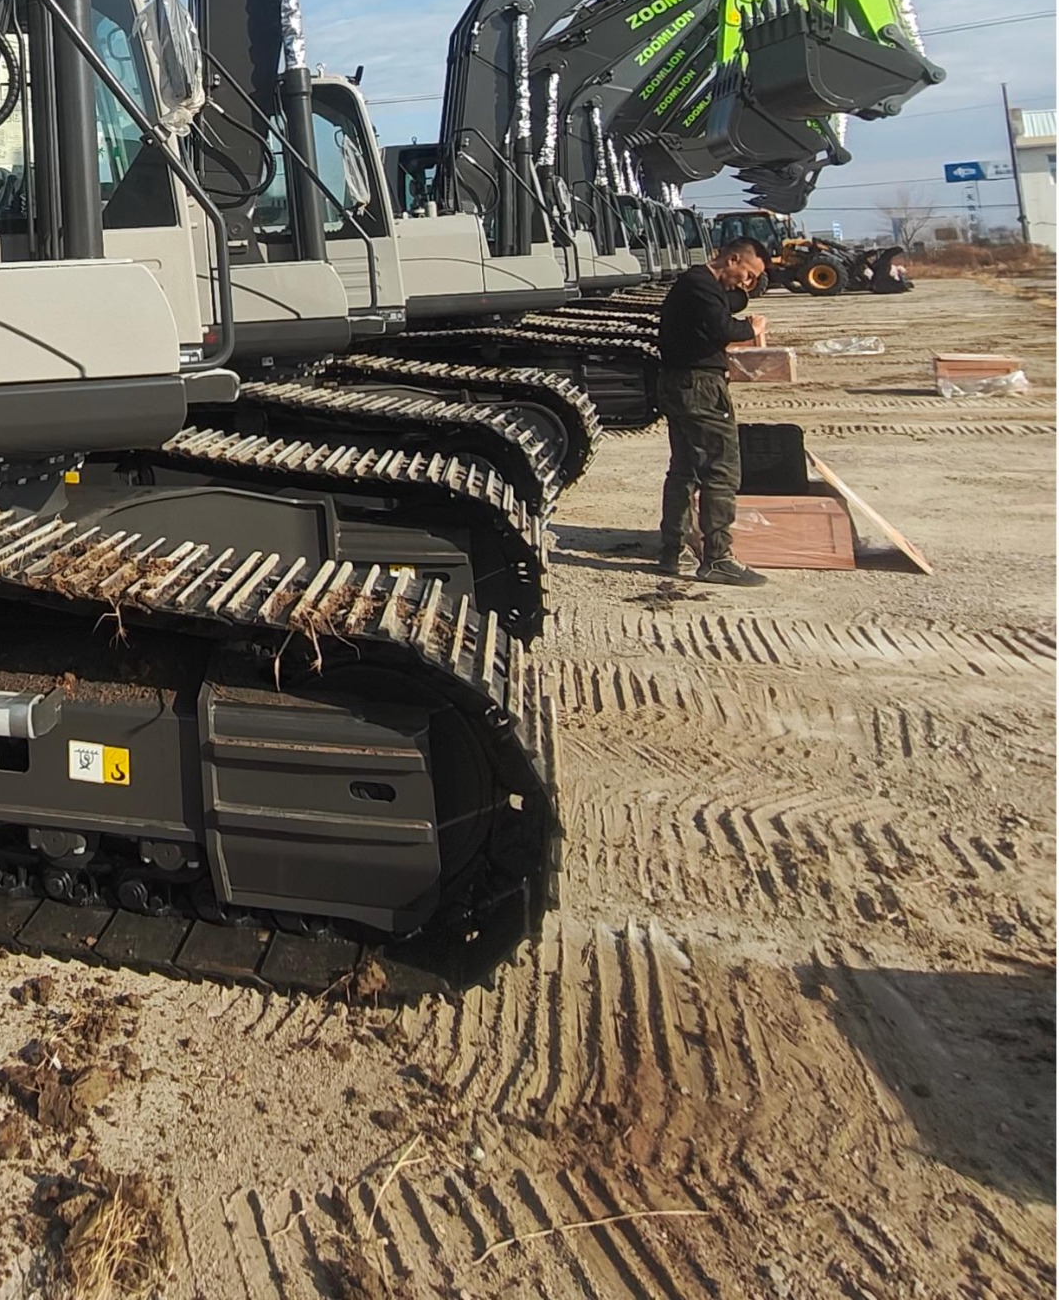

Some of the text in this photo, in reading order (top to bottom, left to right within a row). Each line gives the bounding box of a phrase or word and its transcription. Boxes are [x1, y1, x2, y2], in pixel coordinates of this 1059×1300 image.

[634, 10, 695, 66] ZOOMLION
[639, 48, 686, 100] ZOOMLION
[653, 69, 696, 116] ZOOMLION
